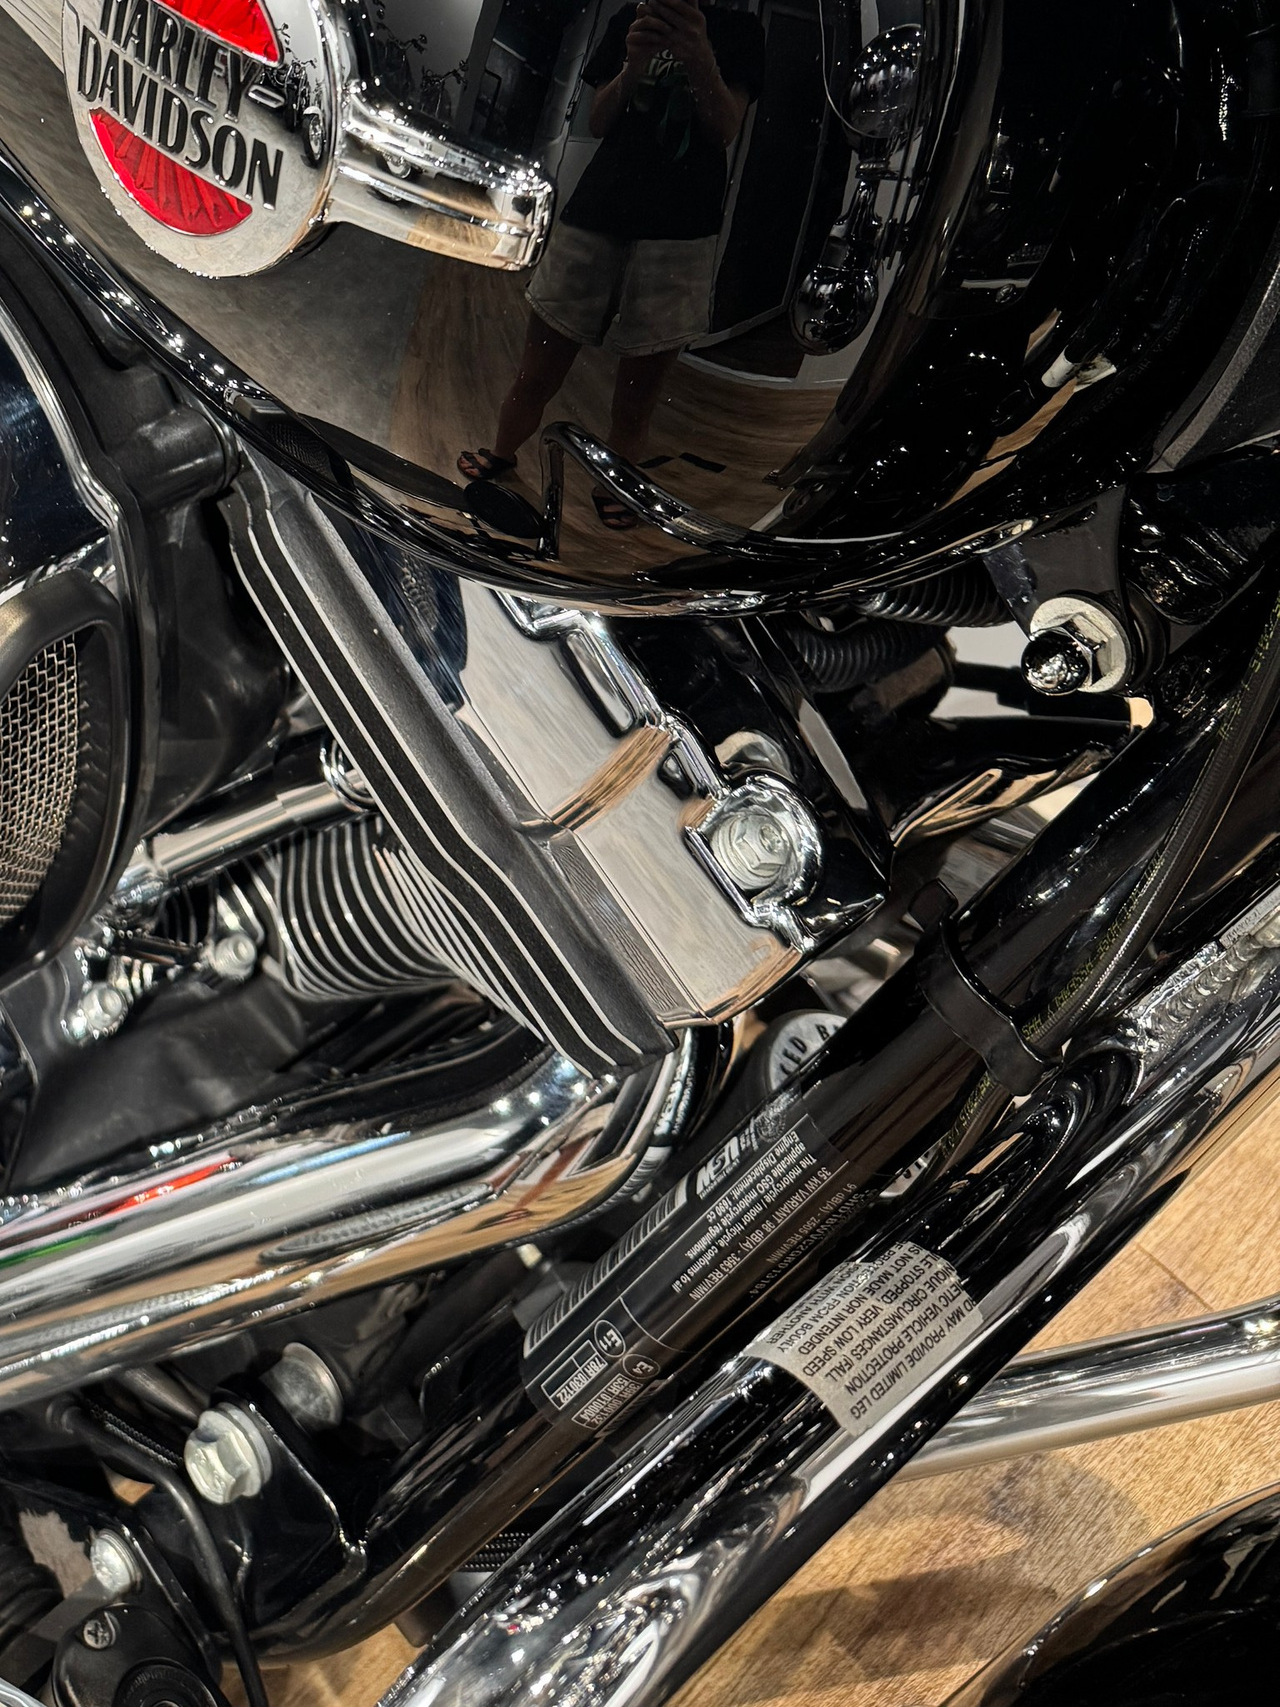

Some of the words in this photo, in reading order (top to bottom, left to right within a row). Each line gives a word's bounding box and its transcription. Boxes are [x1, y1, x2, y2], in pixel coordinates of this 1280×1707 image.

[79, 24, 283, 211] DAVIDSON
[772, 1130, 800, 1157] Engine
[769, 1141, 807, 1178] applicable
[798, 1152, 817, 1169] The
[815, 1165, 832, 1180] 35
[727, 1152, 778, 1200] Displacement:
[754, 1173, 775, 1193] GSO
[762, 1164, 803, 1204] motorcycle
[802, 1175, 821, 1193] kW
[842, 1181, 856, 1194] 91
[712, 1195, 733, 1215] 1690
[718, 1188, 759, 1227] motorcycle
[739, 1201, 764, 1226] motor
[769, 1188, 809, 1224] VARIANT
[818, 1190, 846, 1215] dB(A)
[704, 1210, 717, 1223] cc
[760, 1219, 776, 1233] 98
[798, 1215, 820, 1235] 2505
[683, 1221, 724, 1261] regulations.
[737, 1227, 767, 1252] dB(A)
[765, 1232, 802, 1265] REV/MIN
[685, 1244, 720, 1277] conforms
[889, 1251, 913, 1272] NOT
[670, 1279, 684, 1292] all
[679, 1272, 691, 1284] to
[688, 1267, 724, 1302] REV/MIN
[862, 1268, 894, 1297] MADE
[874, 1263, 925, 1309] STOPPED,
[808, 1297, 840, 1324] FROM
[840, 1290, 869, 1315] NOR
[853, 1302, 883, 1329] VERY
[765, 1307, 812, 1343] ANOTHER
[848, 1286, 928, 1360] CIRCUMSTANCES
[899, 1301, 943, 1342] VEHICLE
[943, 1305, 966, 1332] MAY
[597, 1328, 624, 1351] E11
[797, 1310, 846, 1356] INTENDED
[831, 1324, 859, 1350] LOW
[904, 1323, 948, 1366] PROVIDE
[582, 1357, 604, 1377] 78R
[631, 1359, 653, 1378] E4
[801, 1343, 837, 1377] SPEED
[823, 1353, 855, 1382] (FALL
[843, 1335, 905, 1395] PROTECTION
[555, 1372, 587, 1403] 030122
[606, 1376, 627, 1394] 53R
[868, 1359, 908, 1401] LIMITED
[578, 1392, 611, 1421] 010004
[848, 1395, 872, 1419] LEG
